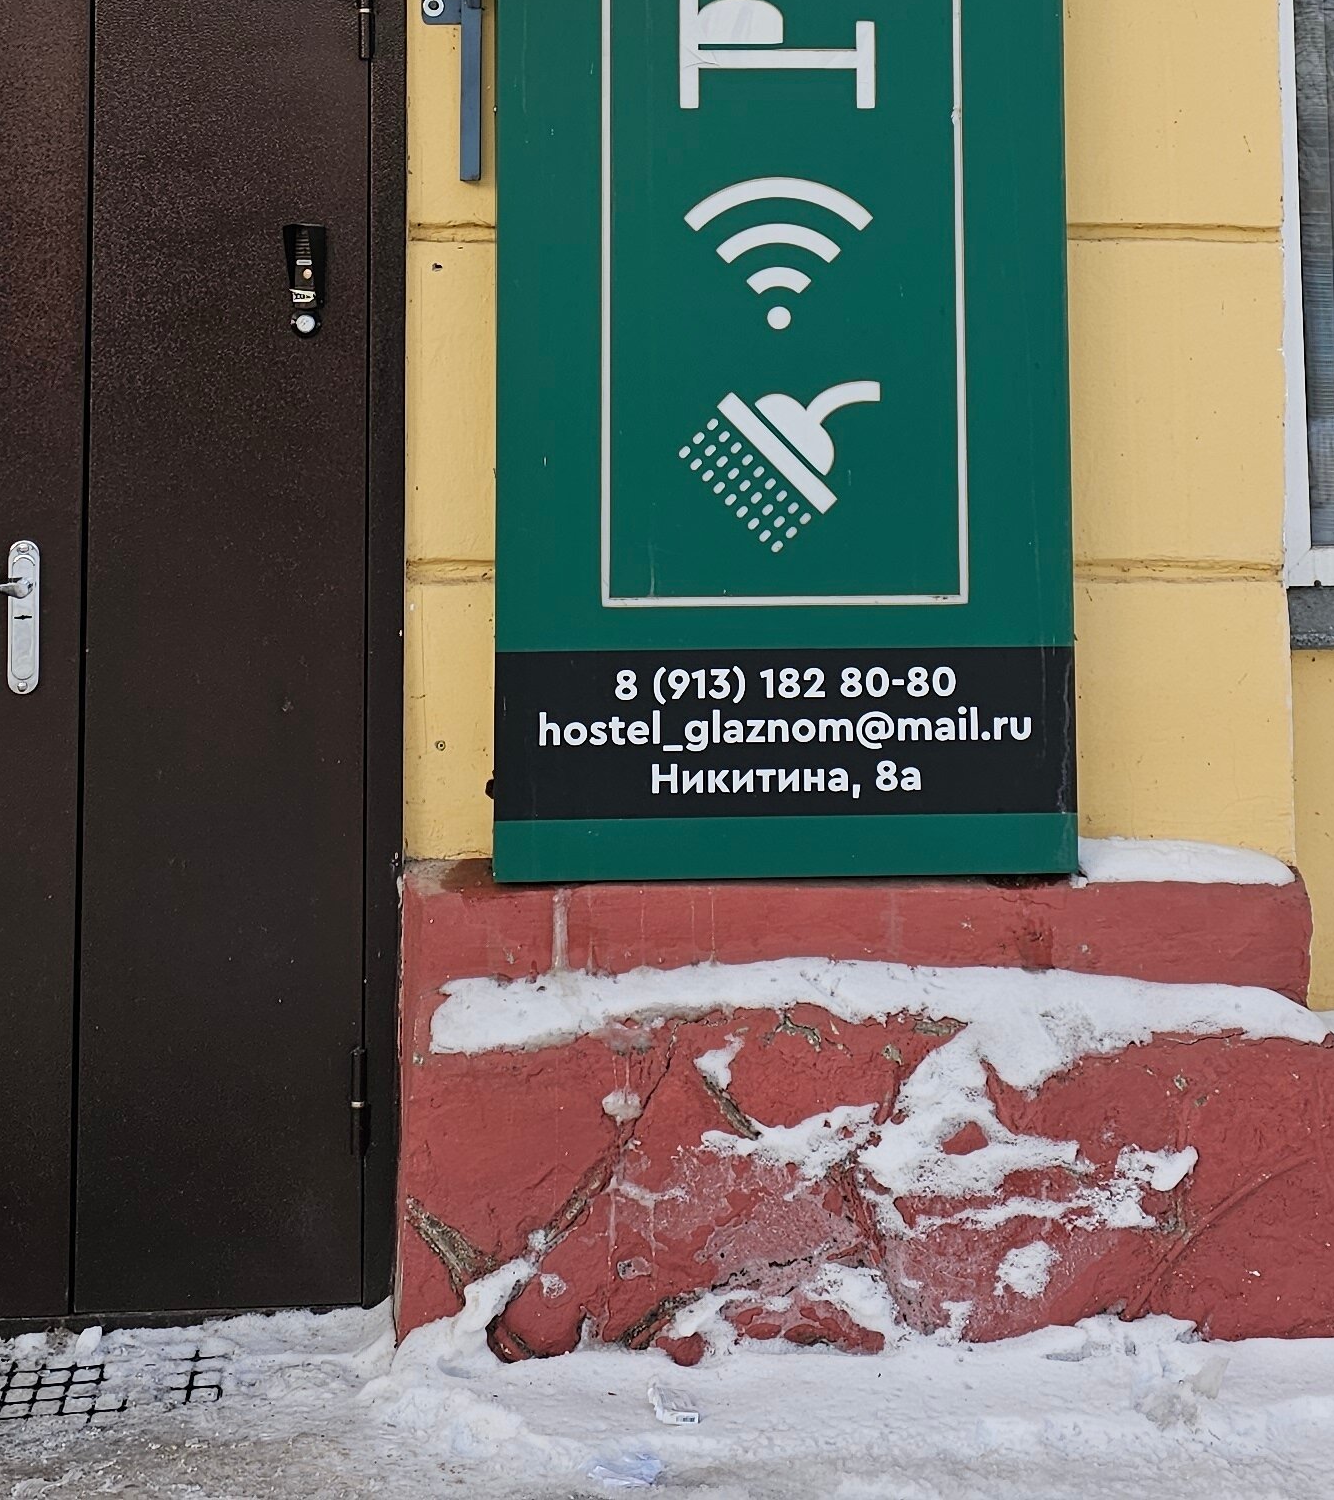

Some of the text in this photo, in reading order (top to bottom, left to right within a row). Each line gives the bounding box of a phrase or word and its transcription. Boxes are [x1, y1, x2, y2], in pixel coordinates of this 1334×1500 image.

[615, 666, 957, 704] 8 (913) 182 80-80
[538, 706, 1032, 751] hostel_glaznom@mail.ru
[652, 761, 922, 798] Никитина, 8а
